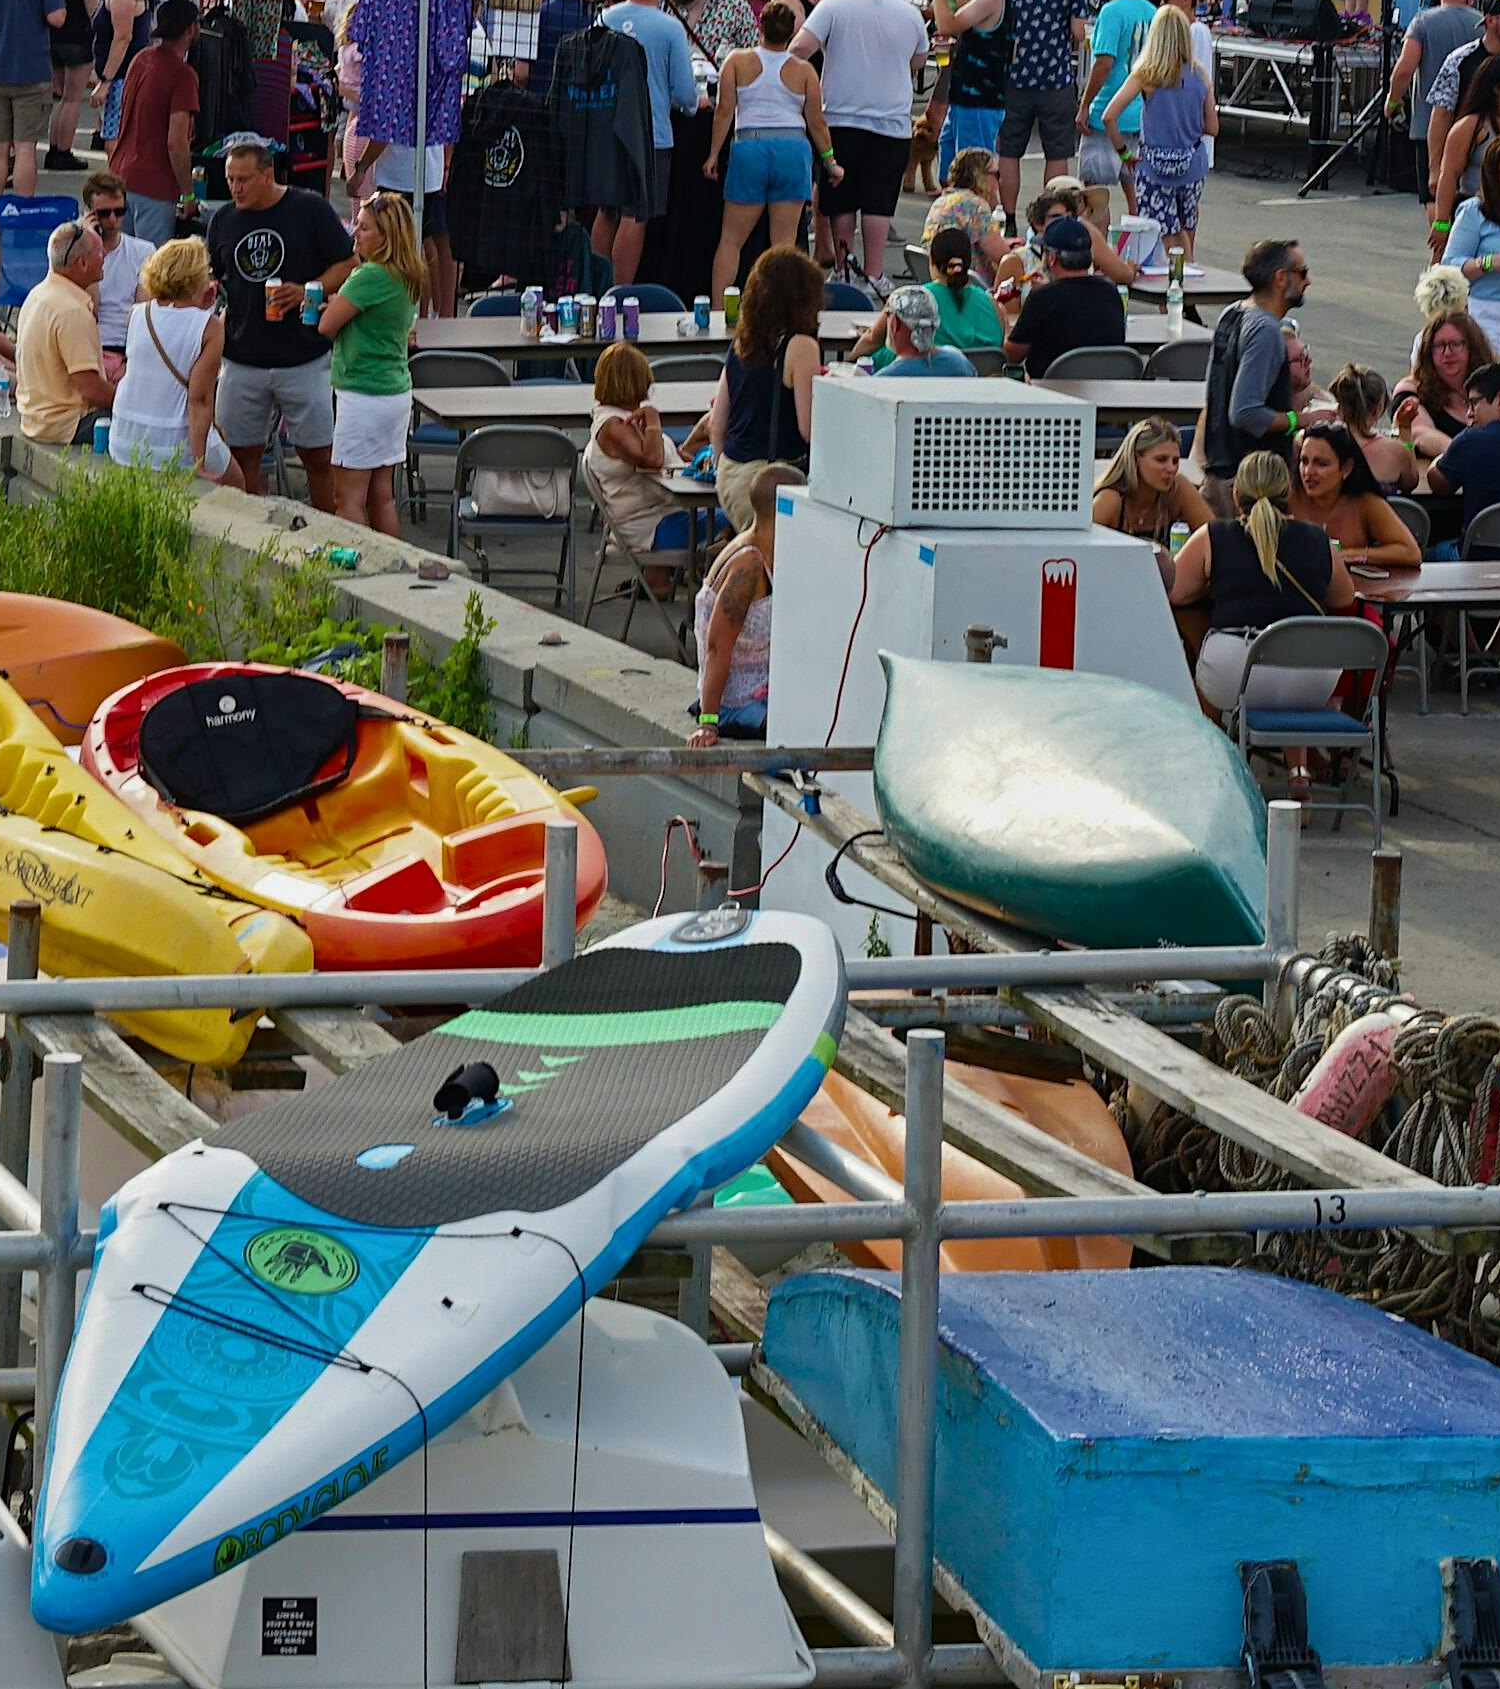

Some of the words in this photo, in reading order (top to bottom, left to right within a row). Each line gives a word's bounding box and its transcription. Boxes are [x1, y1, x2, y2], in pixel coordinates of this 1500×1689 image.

[205, 707, 256, 729] harmony
[1313, 1194, 1347, 1227] 13
[242, 1496, 310, 1561] BODY
[311, 1445, 390, 1518] GLOVE
